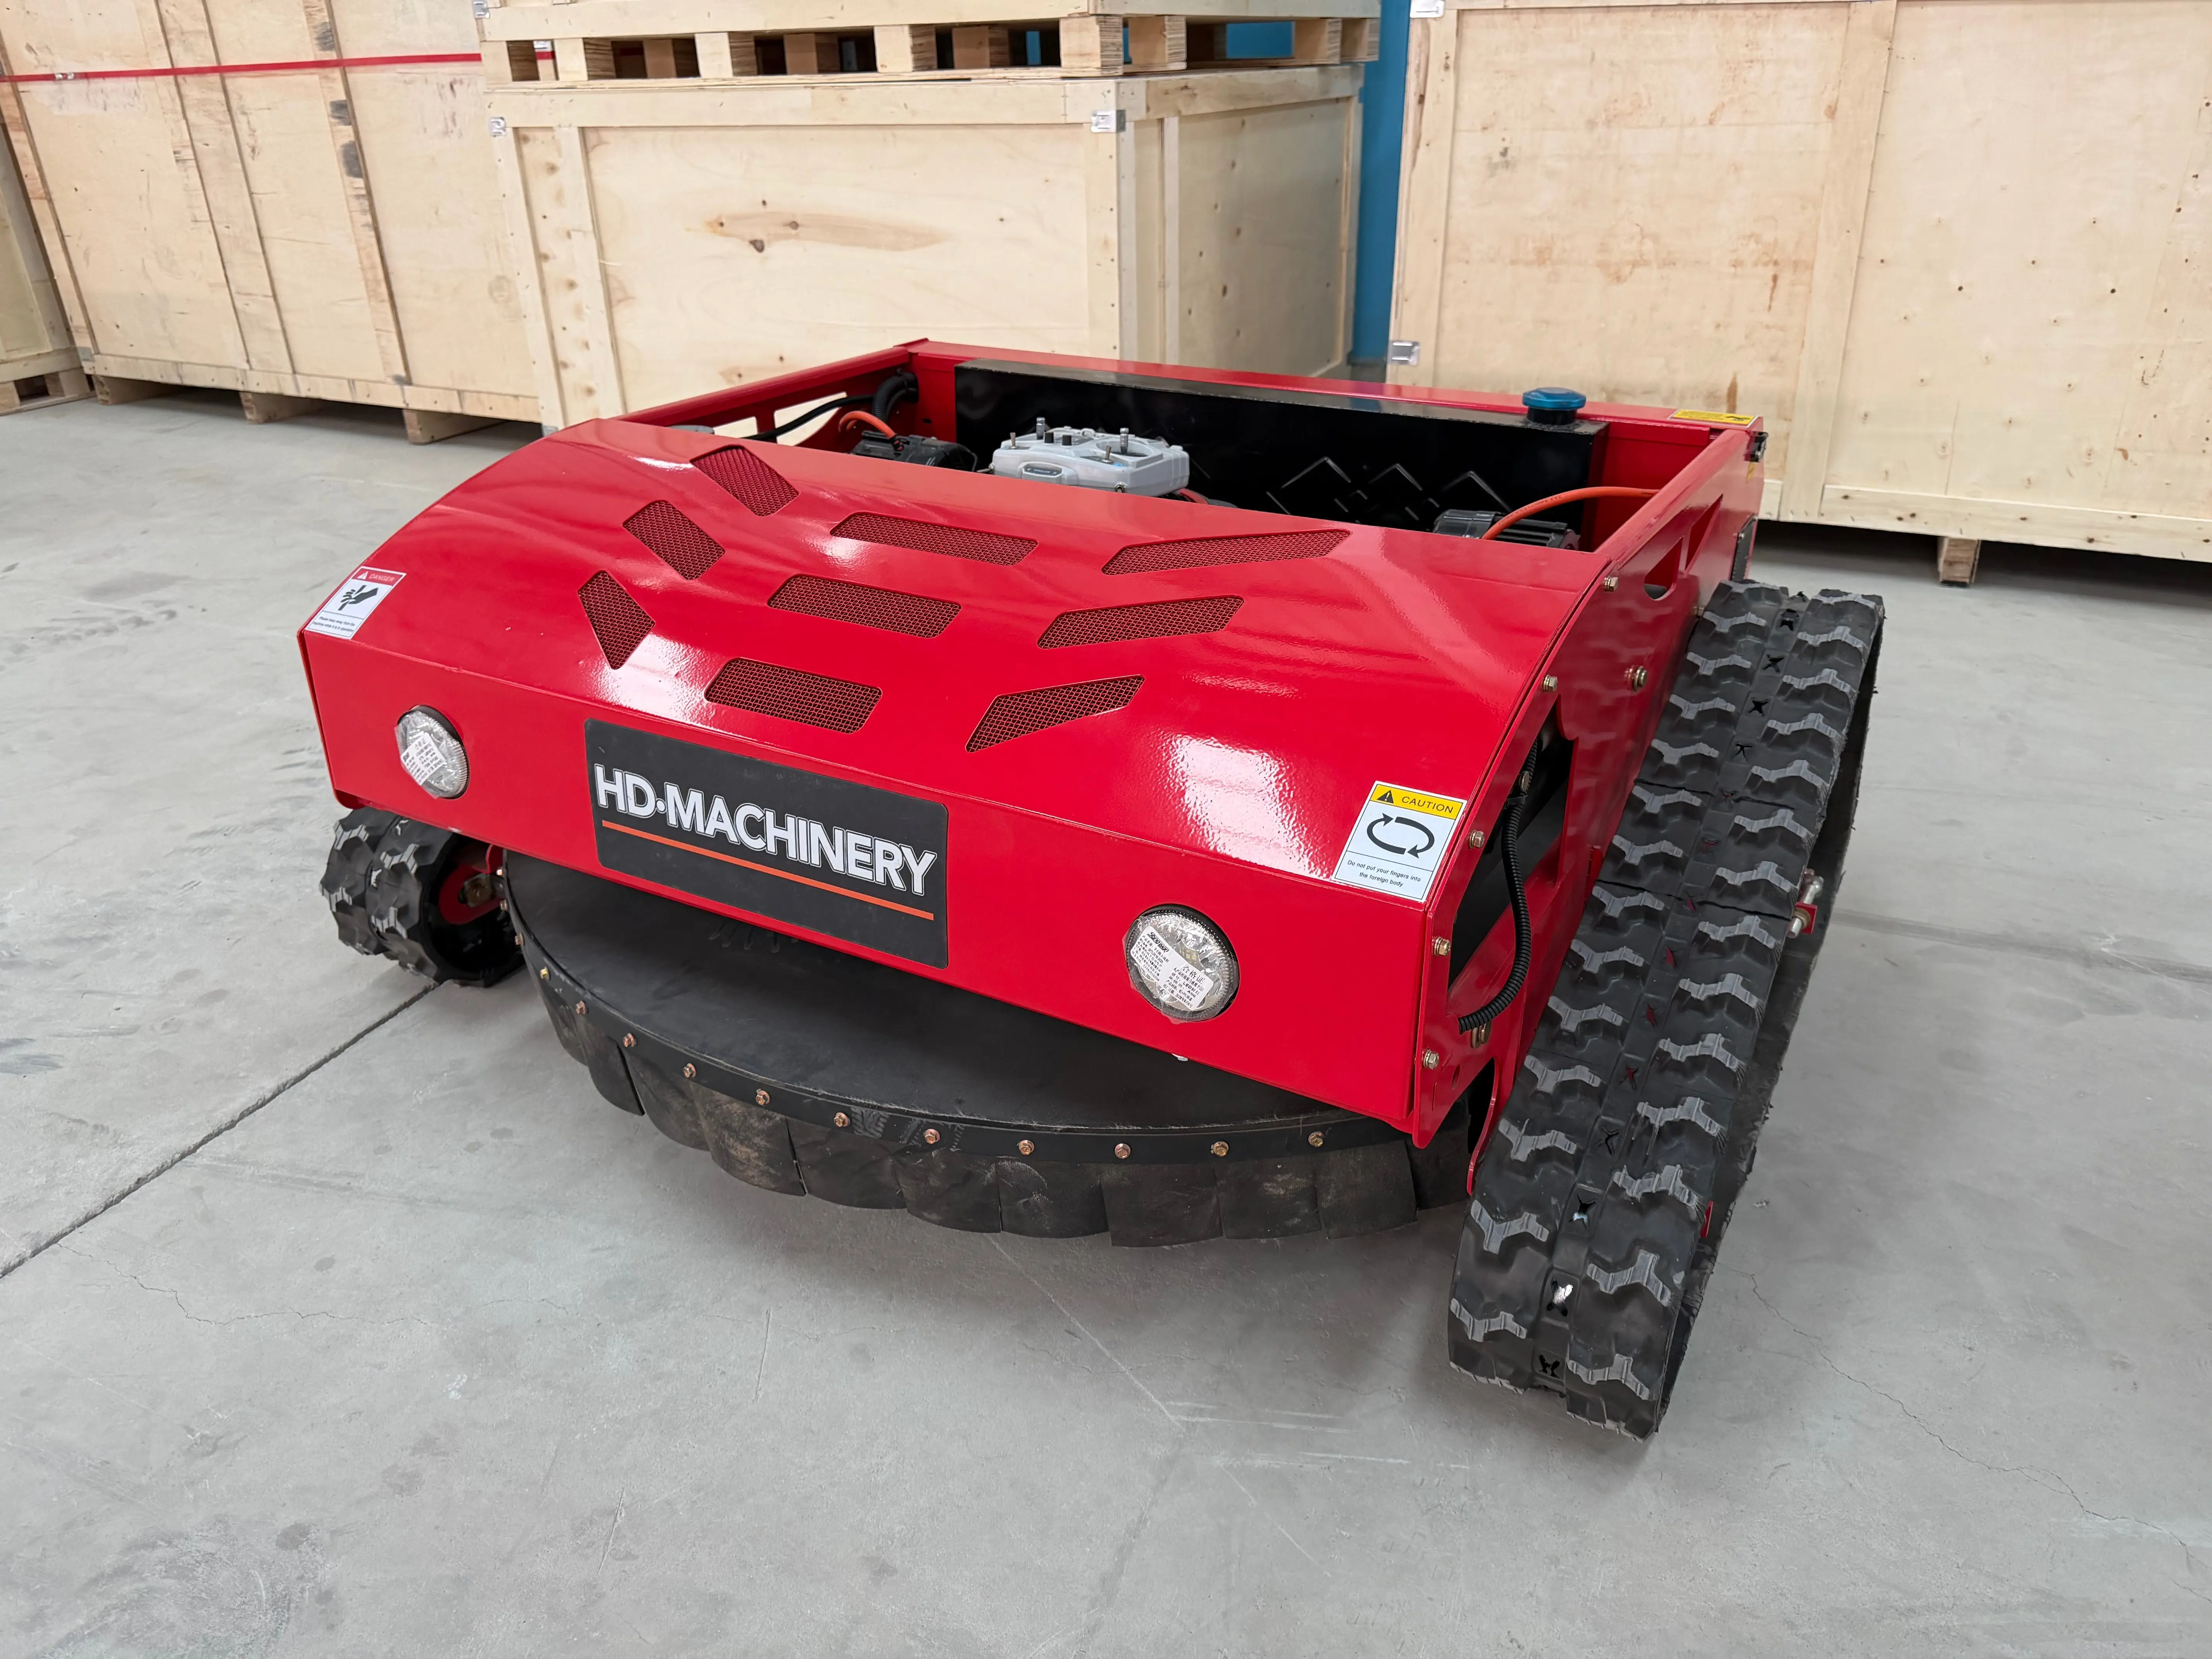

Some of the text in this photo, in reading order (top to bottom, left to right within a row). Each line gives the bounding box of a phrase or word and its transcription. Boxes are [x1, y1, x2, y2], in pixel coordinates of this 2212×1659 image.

[369, 574, 395, 582] DANGER
[1402, 796, 1453, 813] CAUTION
[1369, 874, 1388, 883] foreign
[1389, 879, 1403, 888] body
[1390, 870, 1409, 879] fingers
[1182, 966, 1205, 984] 合格证
